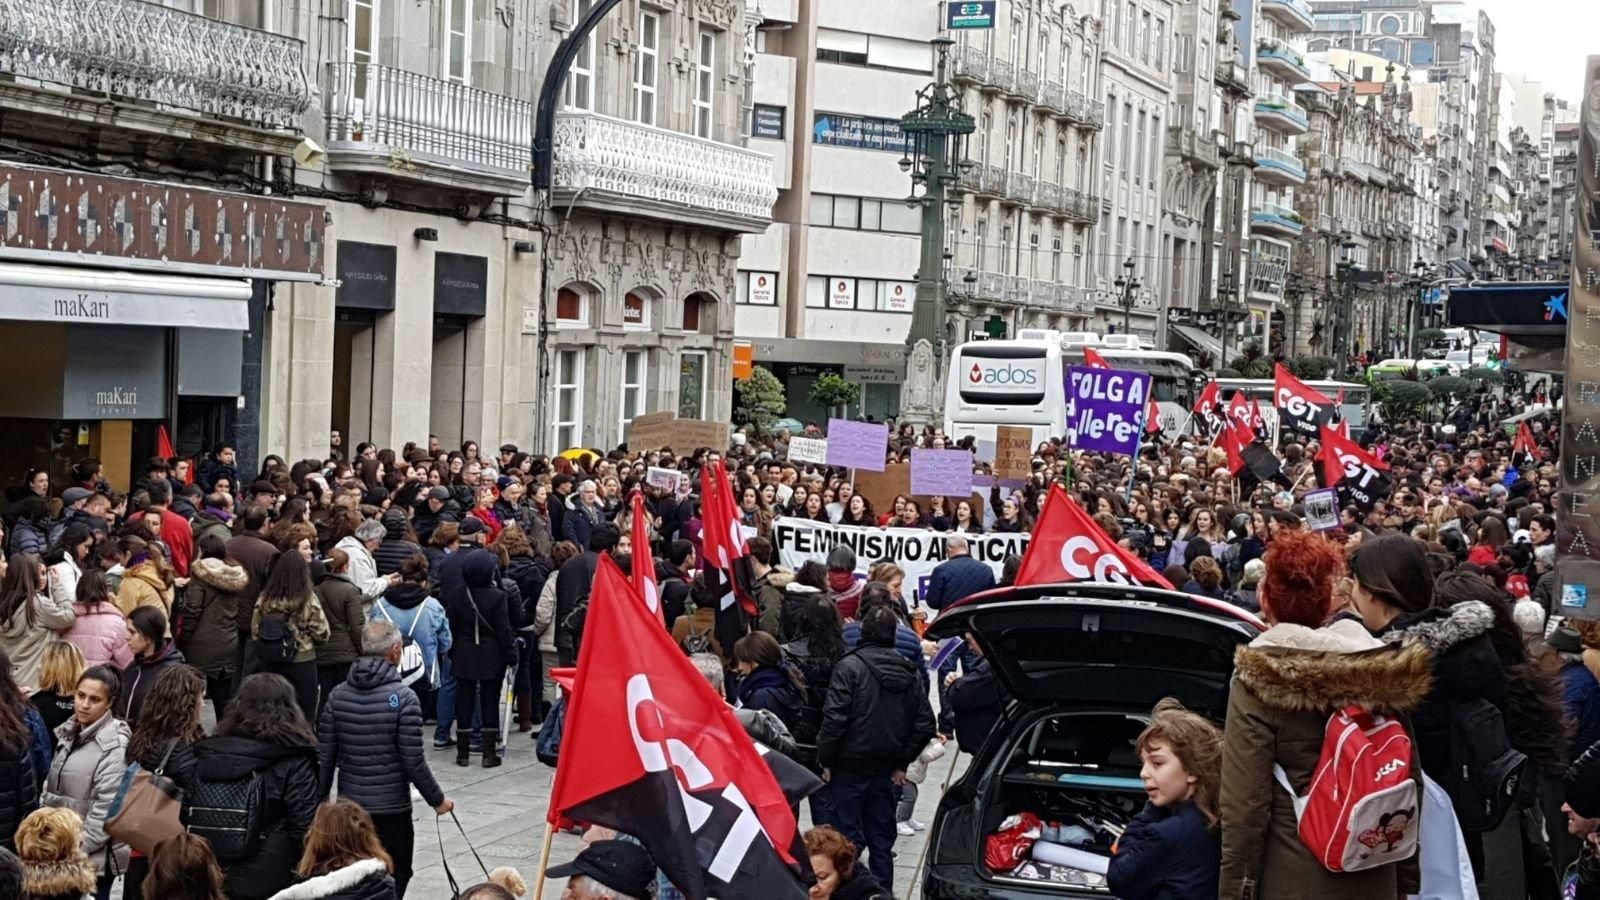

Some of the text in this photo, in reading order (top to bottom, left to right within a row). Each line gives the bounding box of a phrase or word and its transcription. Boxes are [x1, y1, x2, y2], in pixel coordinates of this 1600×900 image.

[54, 294, 109, 318] maKari
[984, 363, 1036, 385] ados
[96, 387, 137, 405] maKari
[1278, 387, 1322, 422] CGT
[1297, 420, 1316, 432] VIGO
[777, 525, 922, 561] FEMINISMO
